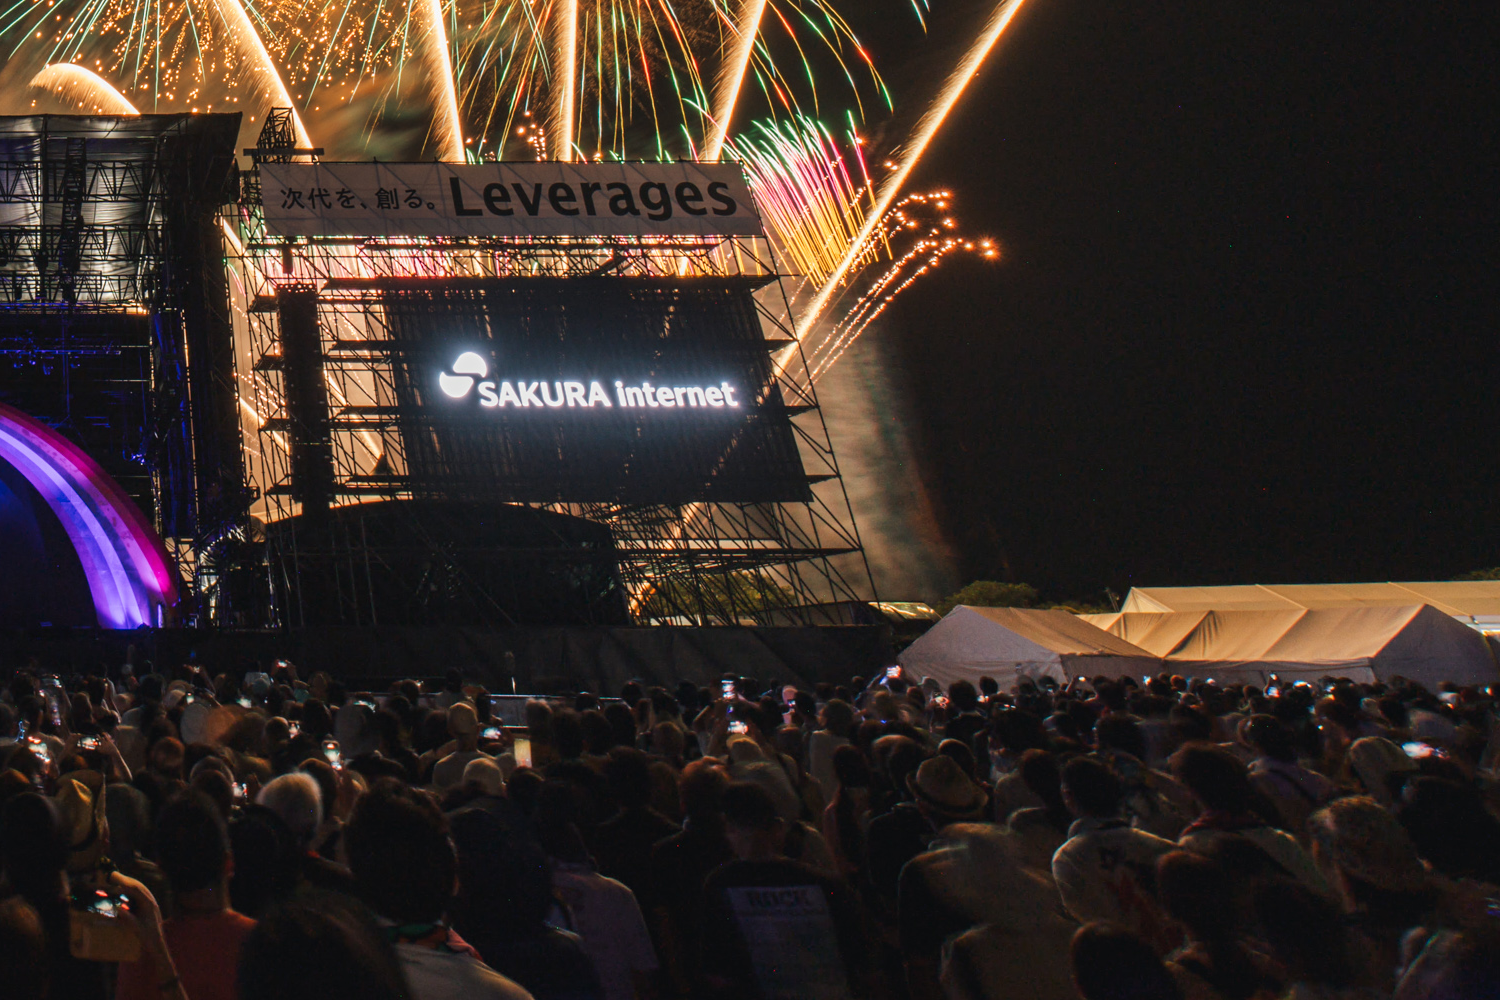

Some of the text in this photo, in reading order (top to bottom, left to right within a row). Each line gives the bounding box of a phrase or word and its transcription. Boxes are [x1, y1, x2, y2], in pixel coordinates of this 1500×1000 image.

[280, 187, 435, 210] 次代を、創る。
[449, 177, 737, 221] Leverages
[478, 381, 739, 408] SAKURA internet
